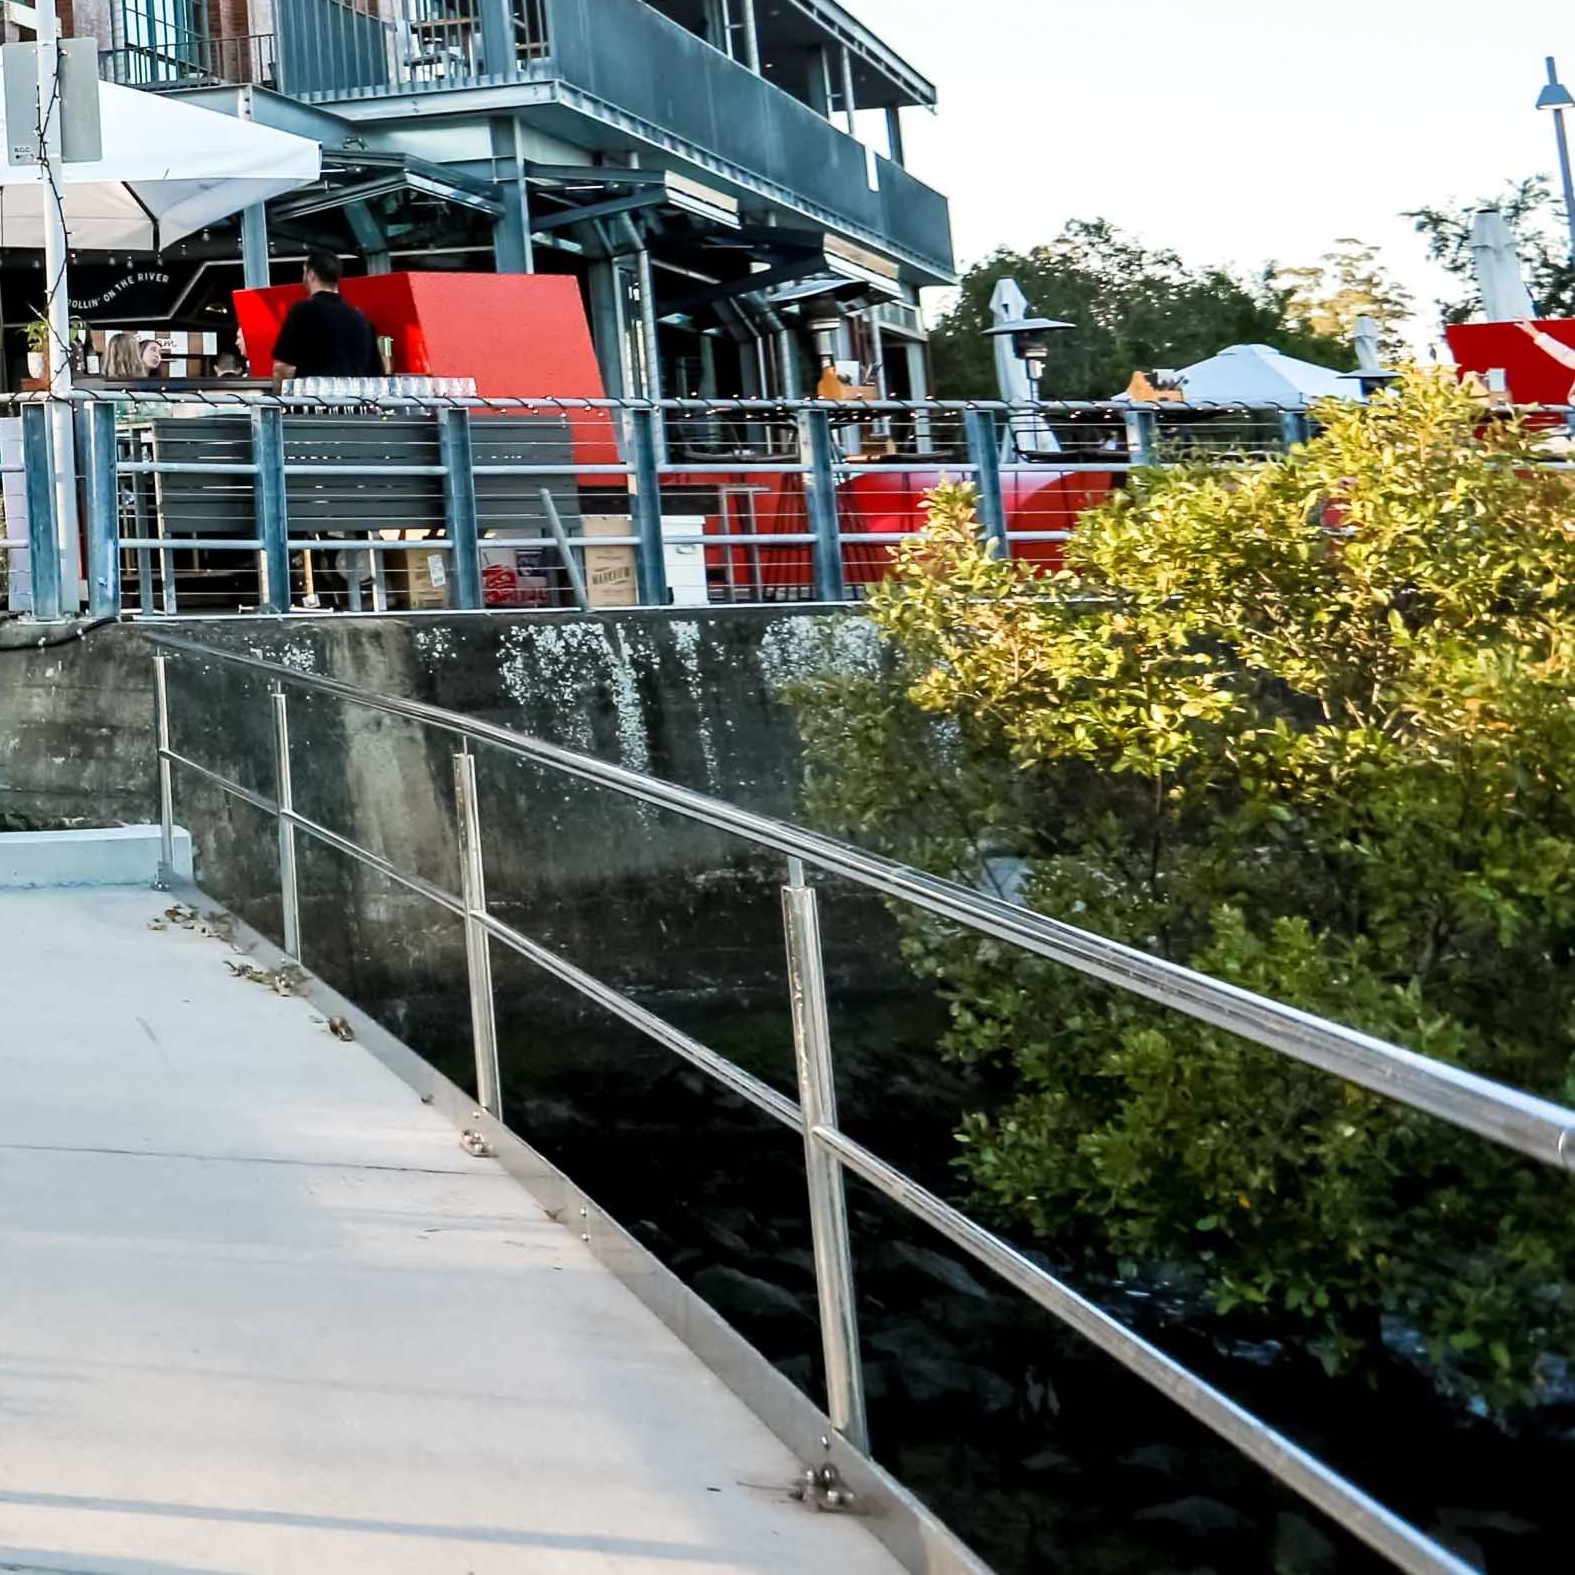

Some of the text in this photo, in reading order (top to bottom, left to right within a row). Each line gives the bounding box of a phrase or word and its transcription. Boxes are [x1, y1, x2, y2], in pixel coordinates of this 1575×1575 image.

[103, 289, 116, 302] ON
[115, 275, 135, 291] THE
[137, 272, 170, 284] RIVER
